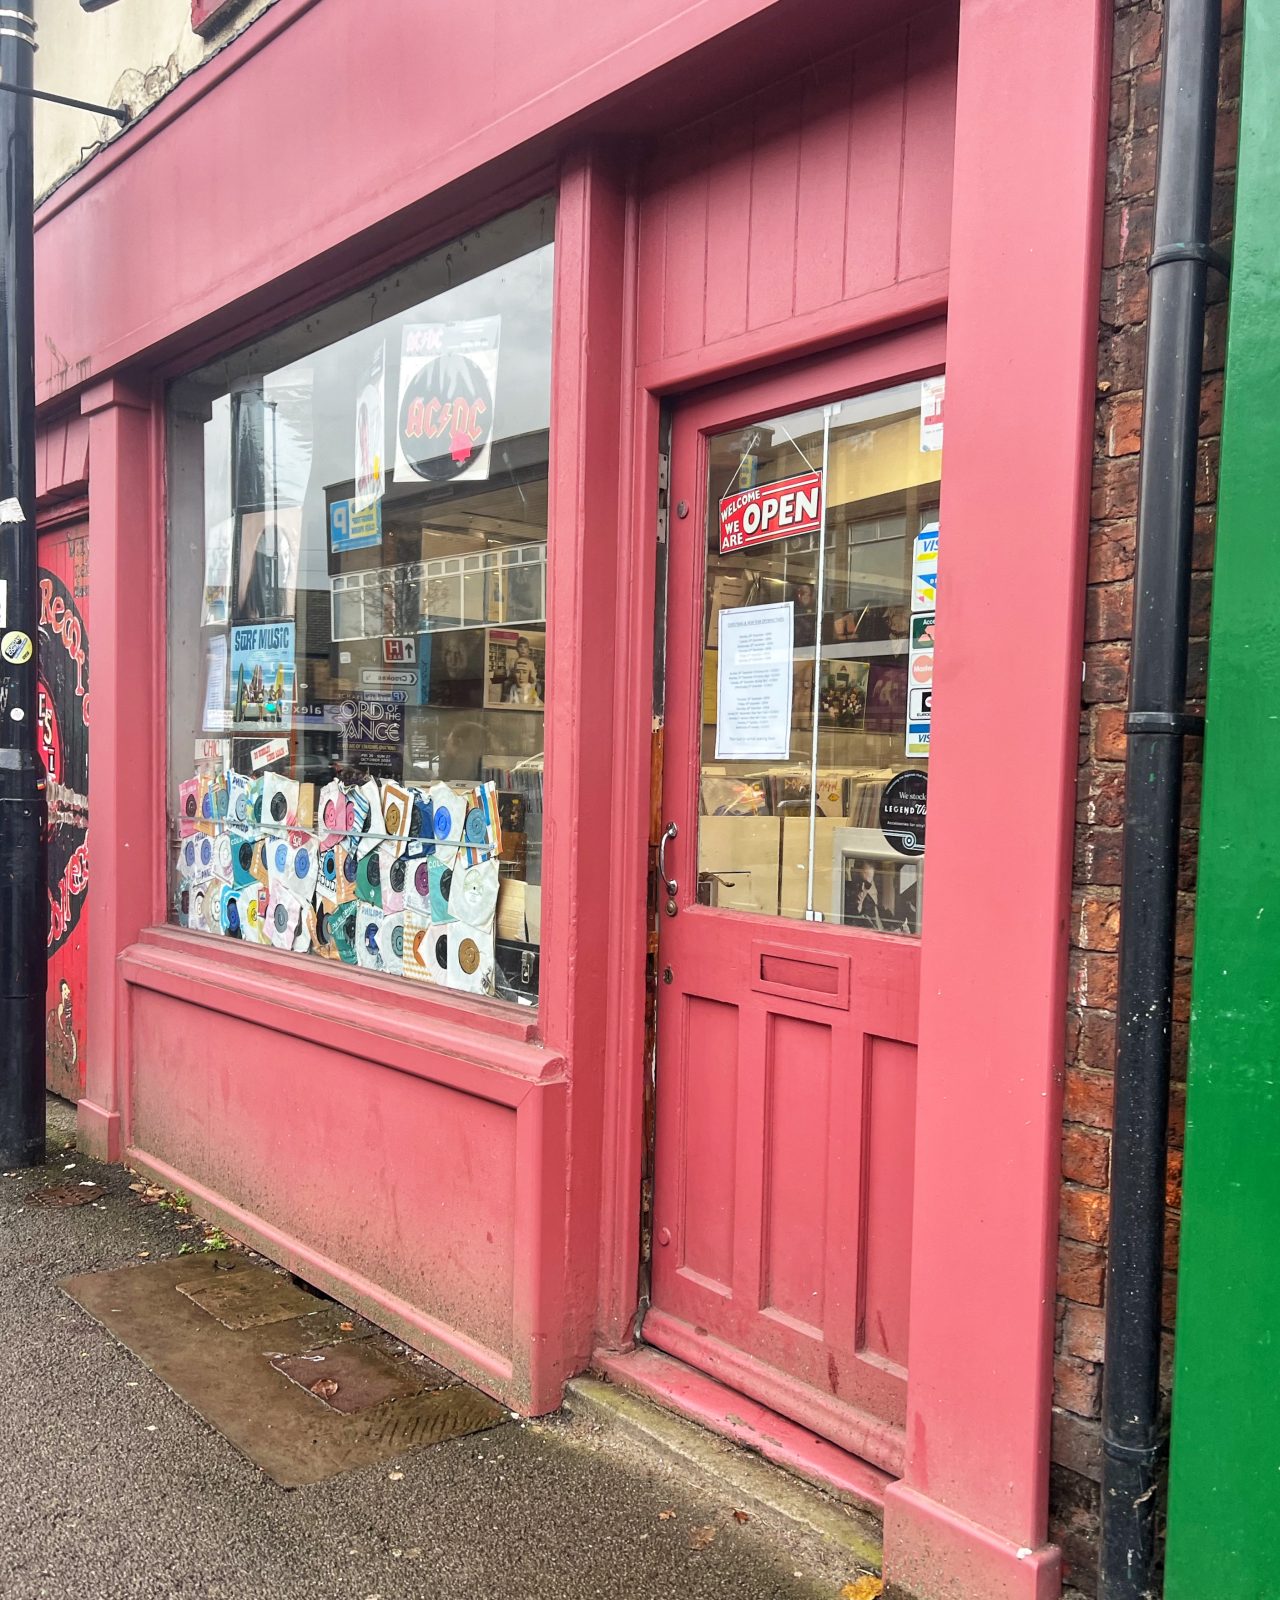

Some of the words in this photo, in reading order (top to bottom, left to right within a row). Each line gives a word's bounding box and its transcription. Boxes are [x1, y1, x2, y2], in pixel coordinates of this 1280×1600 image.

[721, 489, 761, 523] WELCOME
[743, 487, 819, 535] OPEN
[725, 520, 740, 535] WE
[722, 532, 744, 550] ARE
[923, 539, 939, 552] VIS
[234, 629, 258, 652] SURF
[914, 663, 934, 673] Master
[339, 700, 385, 721] ORD
[387, 704, 399, 713] OF
[385, 712, 401, 721] THE
[918, 734, 931, 743] VIS
[899, 791, 909, 800] We
[909, 793, 926, 801] stock
[884, 805, 915, 815] LEGEND
[361, 906, 383, 919] PHILIPS
